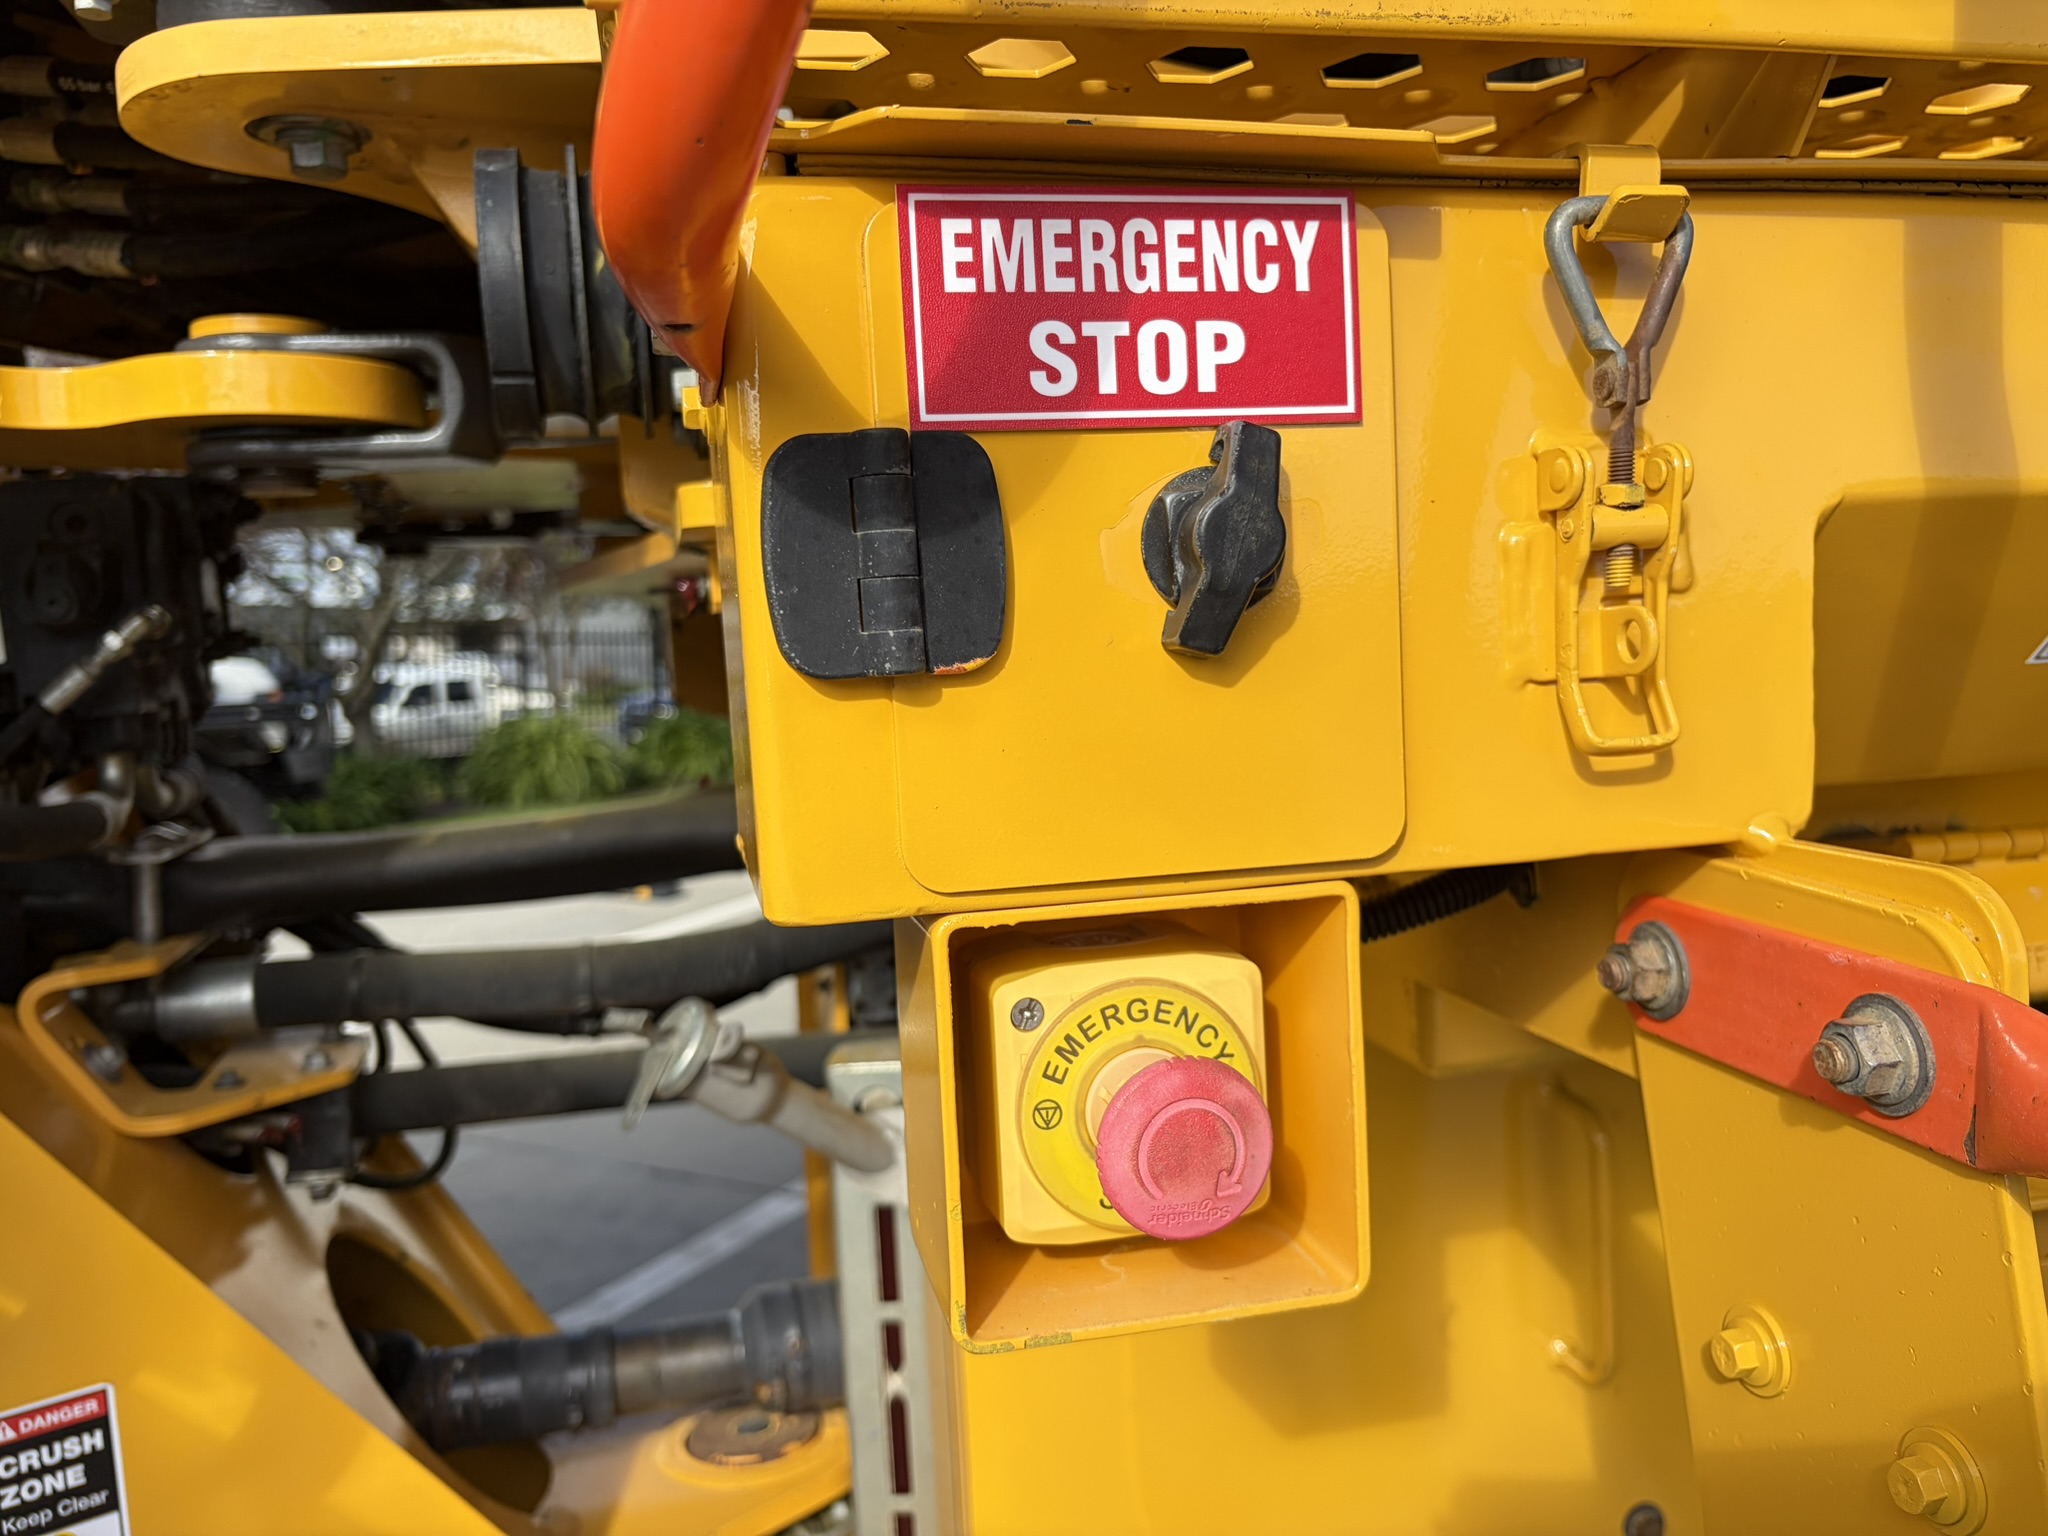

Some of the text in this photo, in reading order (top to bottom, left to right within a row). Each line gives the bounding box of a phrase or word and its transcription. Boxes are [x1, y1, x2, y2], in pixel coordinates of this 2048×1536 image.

[940, 217, 1320, 294] EMERGENCY
[1028, 318, 1246, 397] STOP
[1042, 997, 1235, 1085] EMERGENCY
[1147, 1206, 1231, 1228] Schneider
[1150, 1201, 1198, 1213] Electric
[18, 1398, 99, 1434] DANGER
[0, 1428, 104, 1479] CRUSH
[0, 1463, 87, 1510] ZONE
[2, 1489, 109, 1535] Keep Clear
